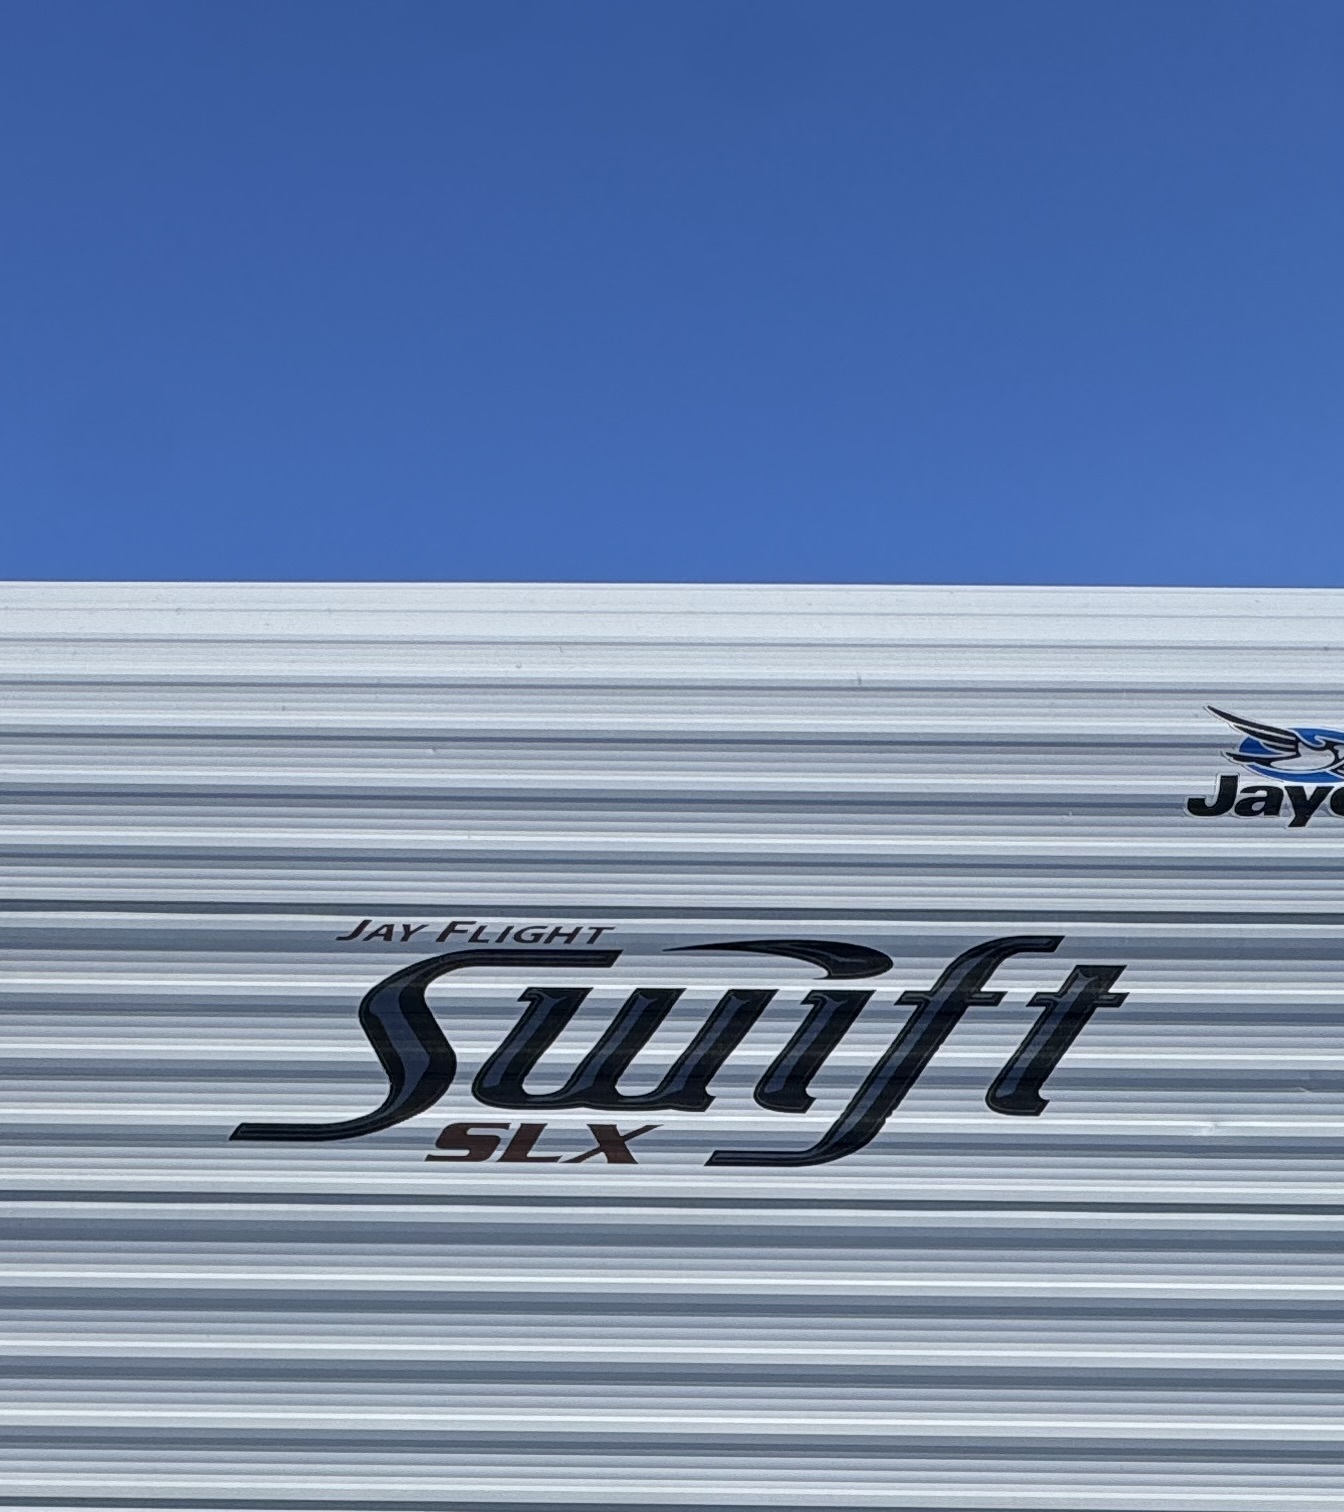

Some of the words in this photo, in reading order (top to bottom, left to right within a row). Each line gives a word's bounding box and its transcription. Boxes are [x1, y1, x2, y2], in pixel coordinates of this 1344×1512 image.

[335, 919, 430, 942] JAY
[435, 920, 626, 945] FLIGHT
[228, 934, 1131, 1168] Swift
[424, 1122, 664, 1165] SLX
